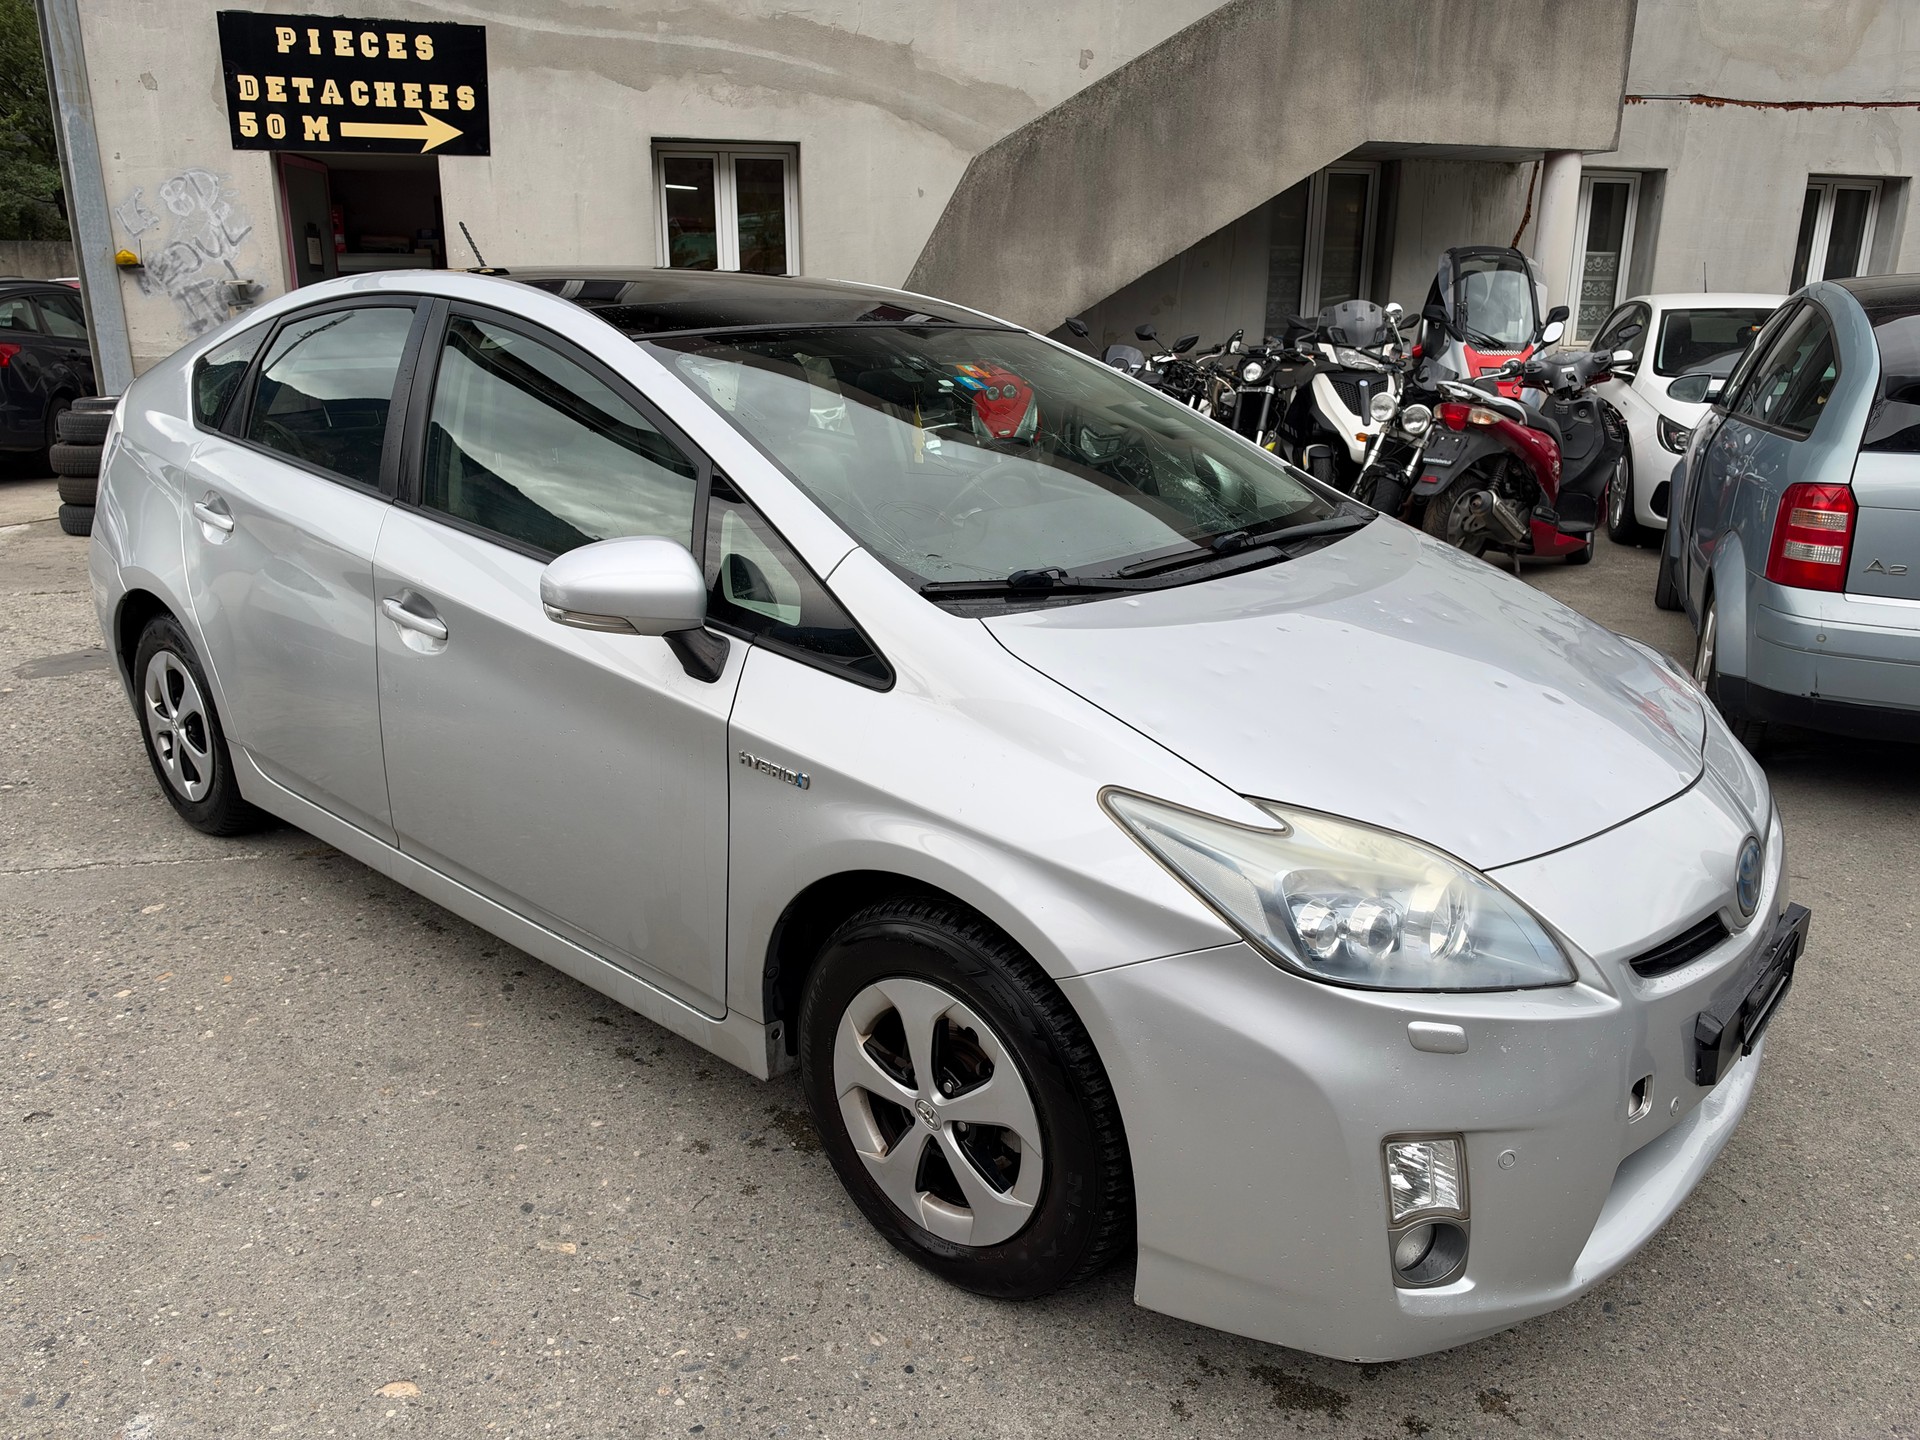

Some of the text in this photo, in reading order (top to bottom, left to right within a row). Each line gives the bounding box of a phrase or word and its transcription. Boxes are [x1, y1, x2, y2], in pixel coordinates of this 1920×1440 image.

[276, 27, 434, 60] PIECES
[238, 75, 475, 111] DETACHEES
[239, 112, 330, 142] 50 M
[1864, 558, 1908, 577] A2
[739, 749, 798, 785] HYBRID
